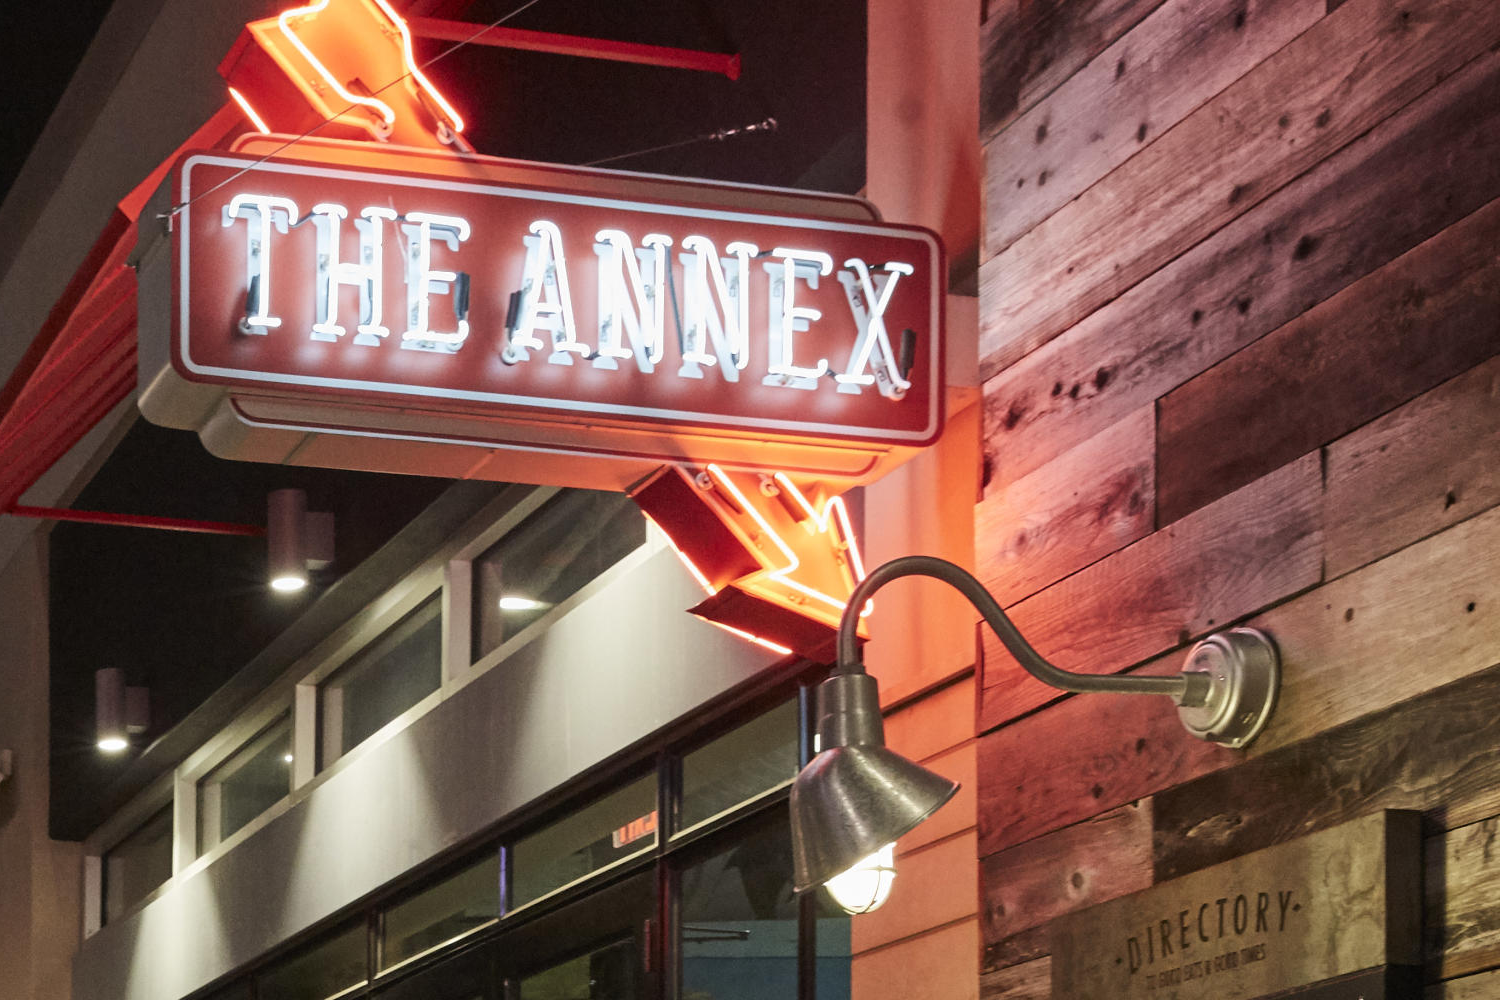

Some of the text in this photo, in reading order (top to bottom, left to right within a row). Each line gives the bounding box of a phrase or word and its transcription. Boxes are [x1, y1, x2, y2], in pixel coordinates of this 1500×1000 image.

[222, 193, 914, 401] THE ANNEX
[1127, 890, 1293, 975] DIRECTORY
